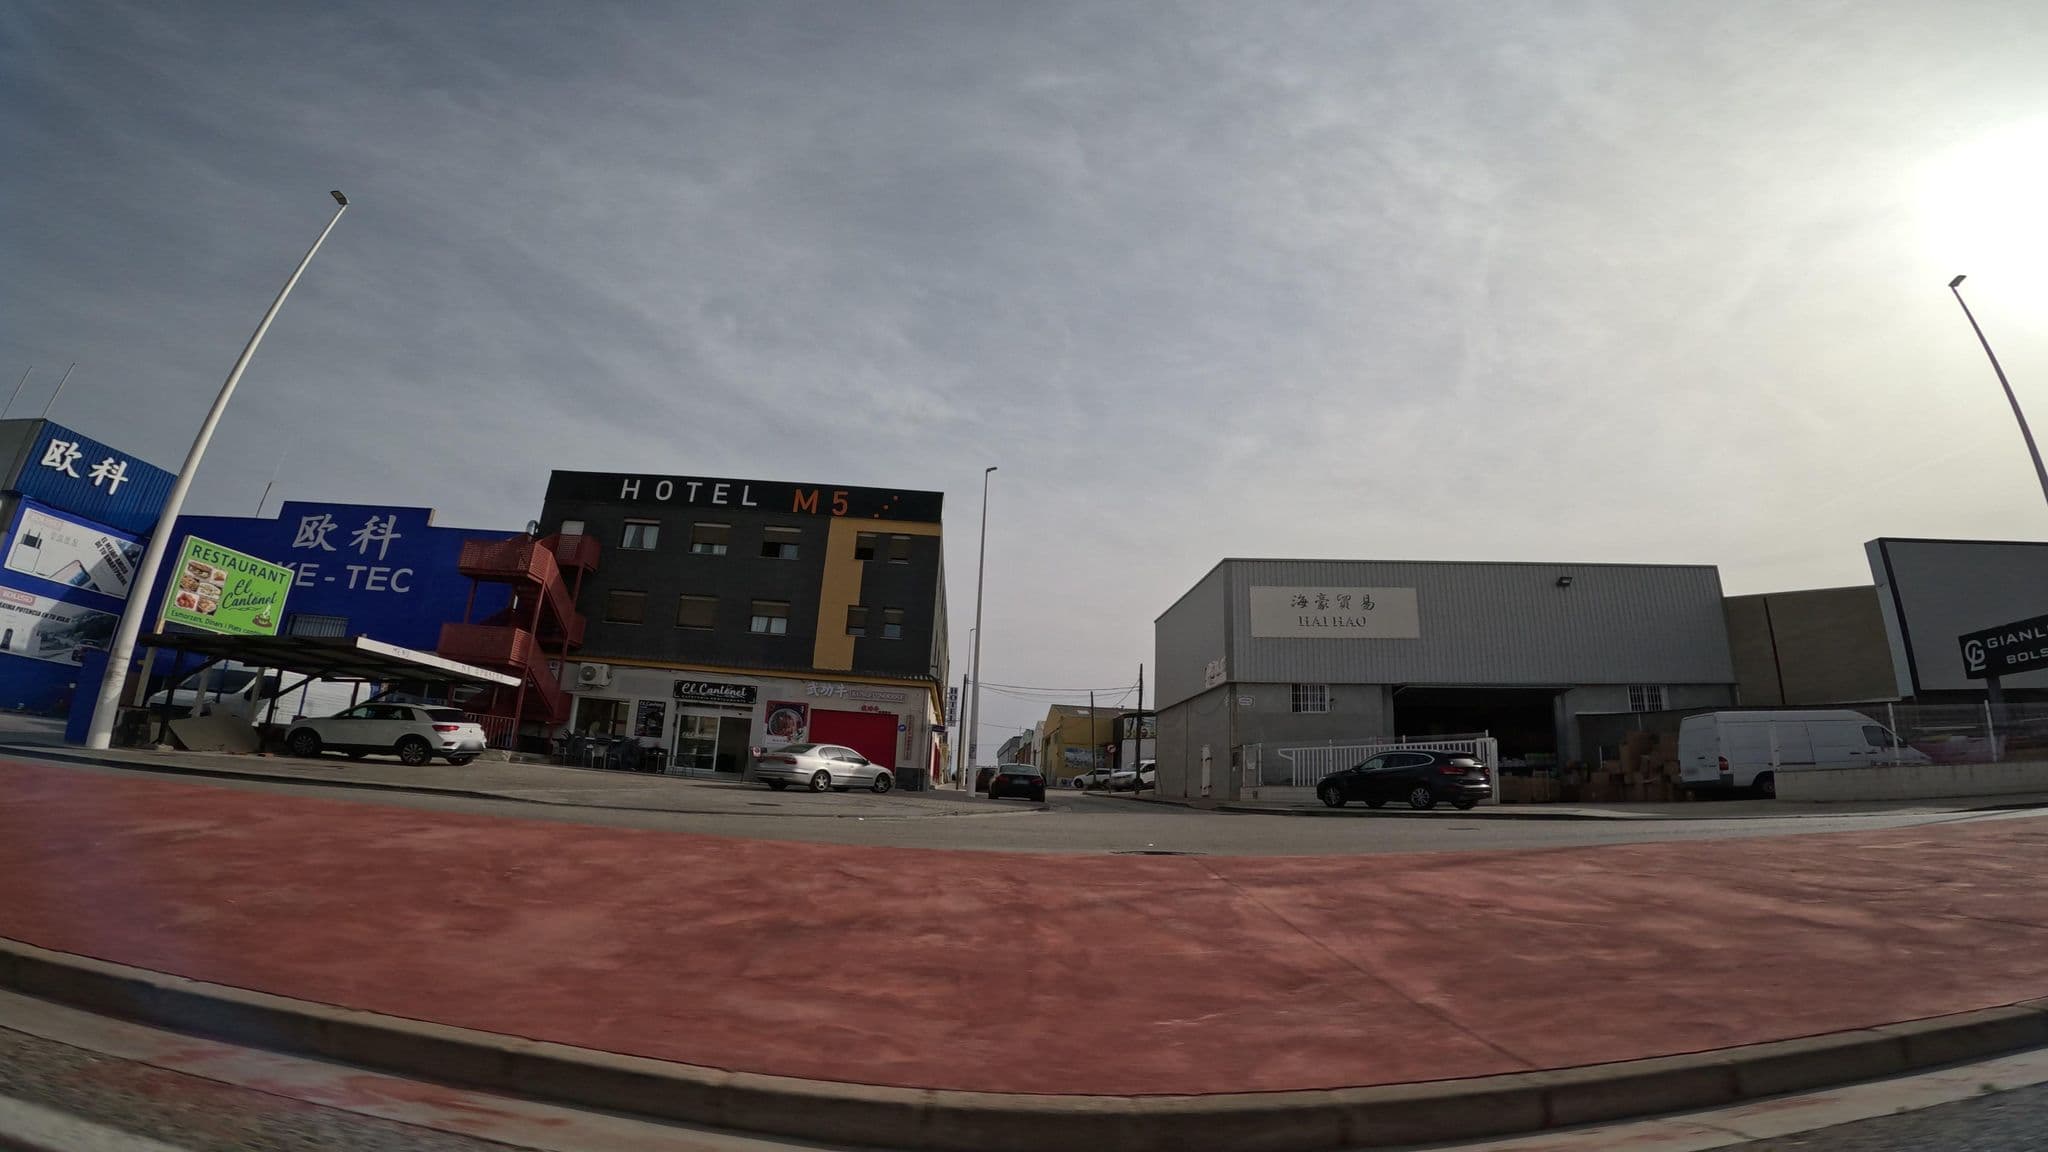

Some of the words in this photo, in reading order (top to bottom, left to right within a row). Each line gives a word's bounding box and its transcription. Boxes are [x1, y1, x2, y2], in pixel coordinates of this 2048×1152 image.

[41, 438, 128, 495] 欧科
[620, 479, 758, 506] HOTEL
[292, 513, 402, 561] 欧科
[191, 544, 288, 585] RESTAURANT
[346, 564, 414, 593] TEC
[234, 579, 252, 595] El
[1986, 624, 2048, 649] GIANL
[681, 682, 697, 694] El
